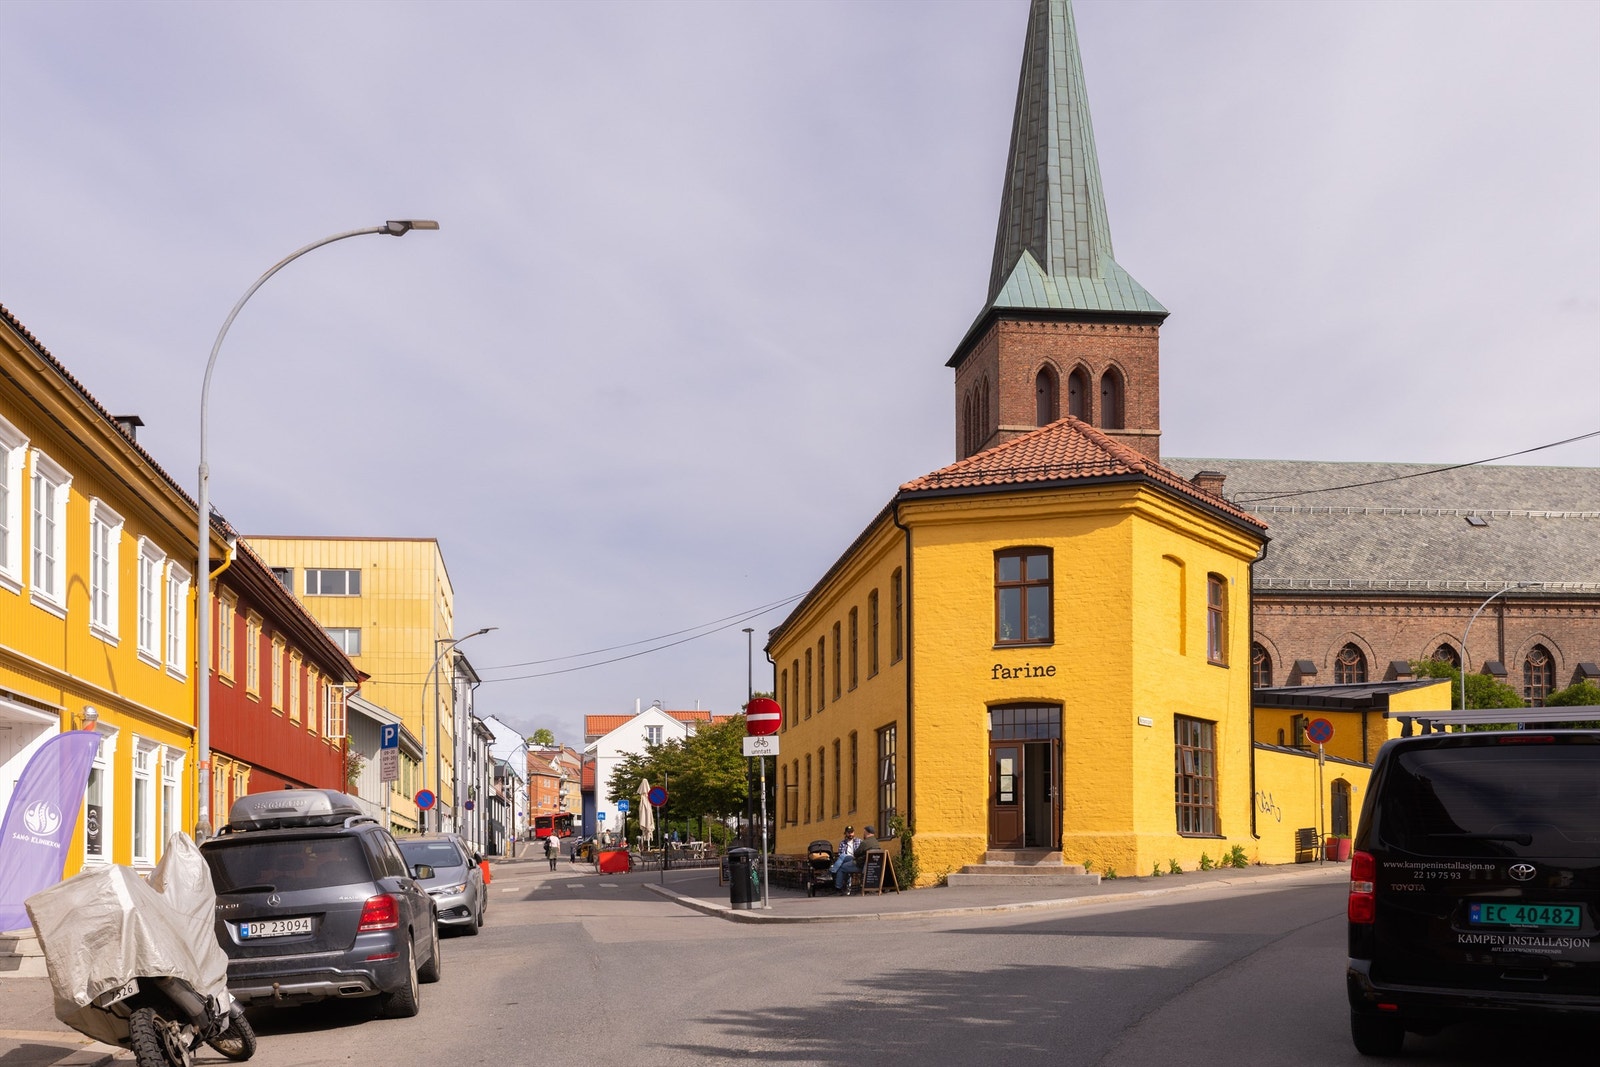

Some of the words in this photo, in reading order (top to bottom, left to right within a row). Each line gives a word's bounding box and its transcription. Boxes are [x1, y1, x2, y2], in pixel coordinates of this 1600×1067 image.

[991, 662, 1056, 680] farine
[384, 727, 395, 746] P
[1383, 861, 1496, 871] www.kampeninstallasjon.no
[1413, 871, 1424, 879] 22
[1426, 871, 1437, 879] 19
[1438, 872, 1449, 880] 75
[1450, 872, 1461, 880] 93
[1390, 883, 1426, 892] TOYOTA
[1486, 906, 1507, 922] EC
[1515, 907, 1575, 924] 40482
[251, 923, 266, 935] DP
[272, 919, 309, 933] 23094
[1458, 934, 1505, 945] KAMPEN
[1508, 935, 1591, 949] INSTALLASJON
[110, 985, 133, 1001] 7526
